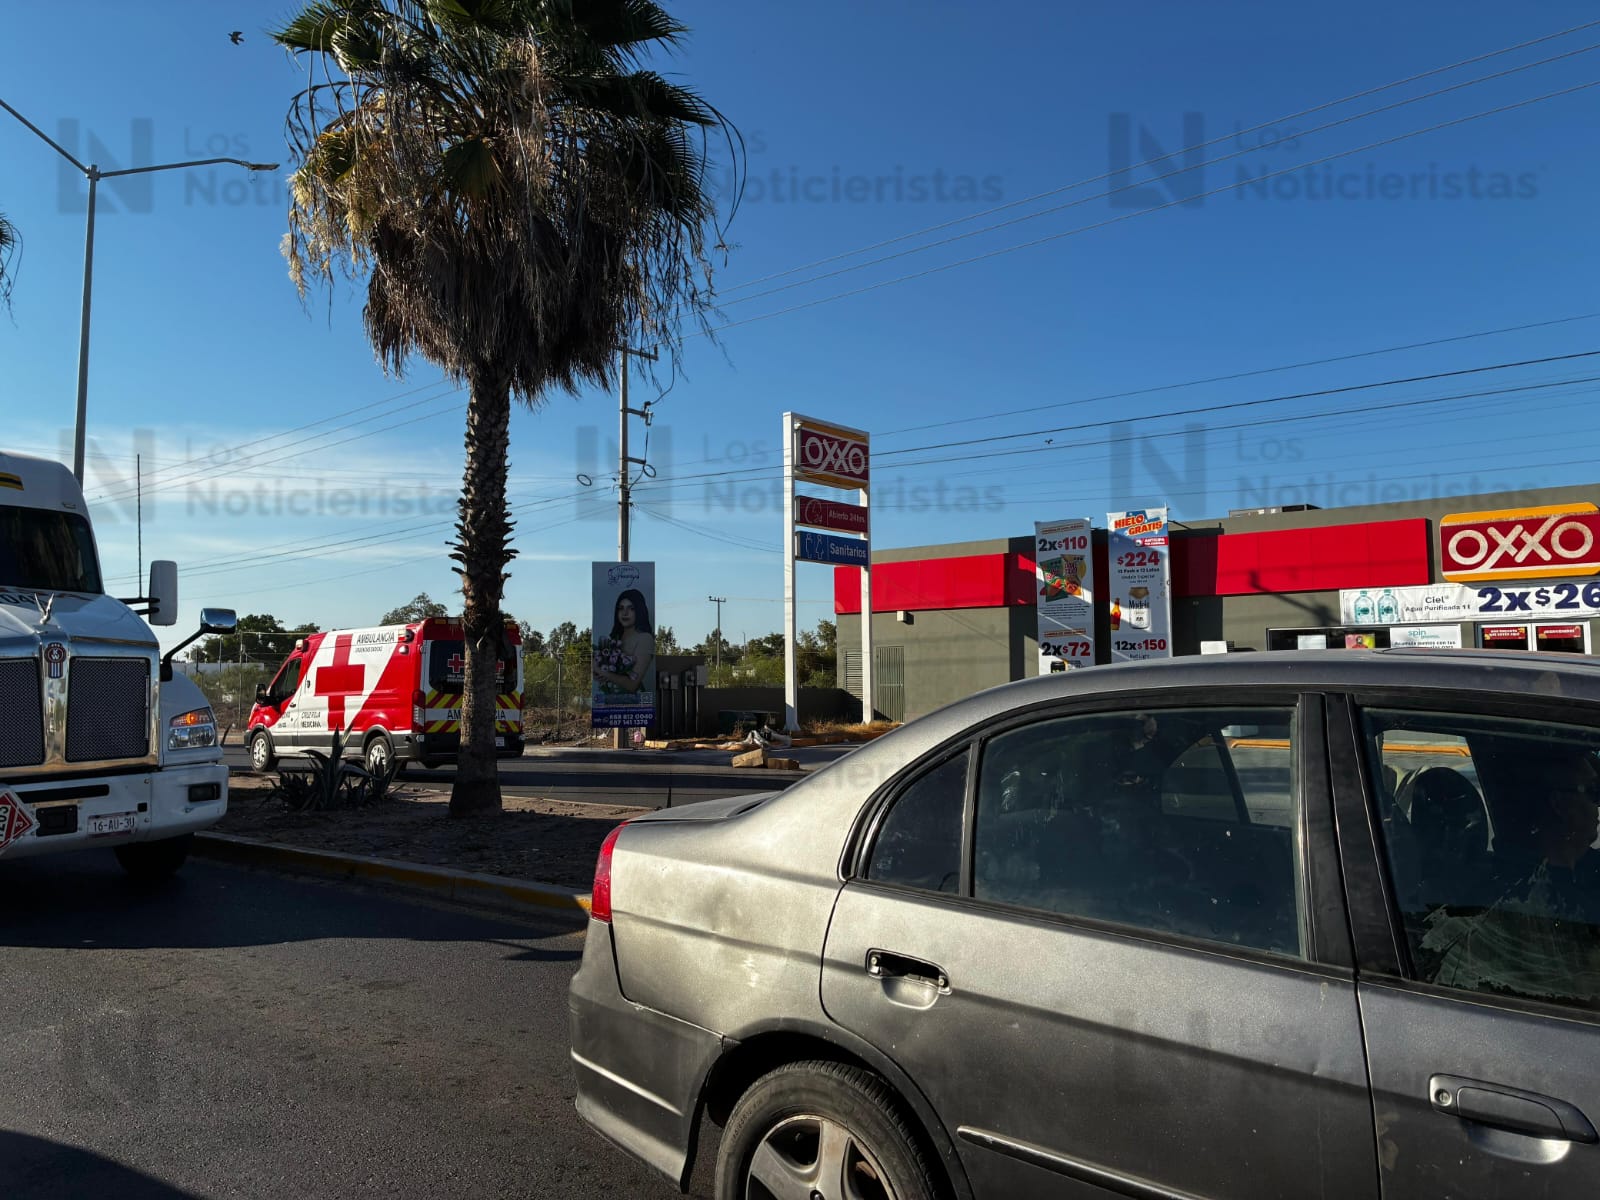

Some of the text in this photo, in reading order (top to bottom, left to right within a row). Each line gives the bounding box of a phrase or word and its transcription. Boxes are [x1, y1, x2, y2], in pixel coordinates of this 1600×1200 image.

[804, 436, 866, 475] OXXO
[829, 510, 849, 521] Abierto
[1114, 515, 1144, 529] HIELO
[1128, 521, 1163, 536] GRATIS
[829, 542, 867, 559] Sanitarios
[1038, 535, 1088, 552] 2x$110
[1448, 517, 1594, 571] OXXO
[1117, 550, 1161, 568] $224
[357, 632, 395, 643] AMBULANCIA
[1408, 628, 1427, 637] spin
[1041, 641, 1091, 656] 2x$72
[1115, 639, 1167, 651] 12x$150
